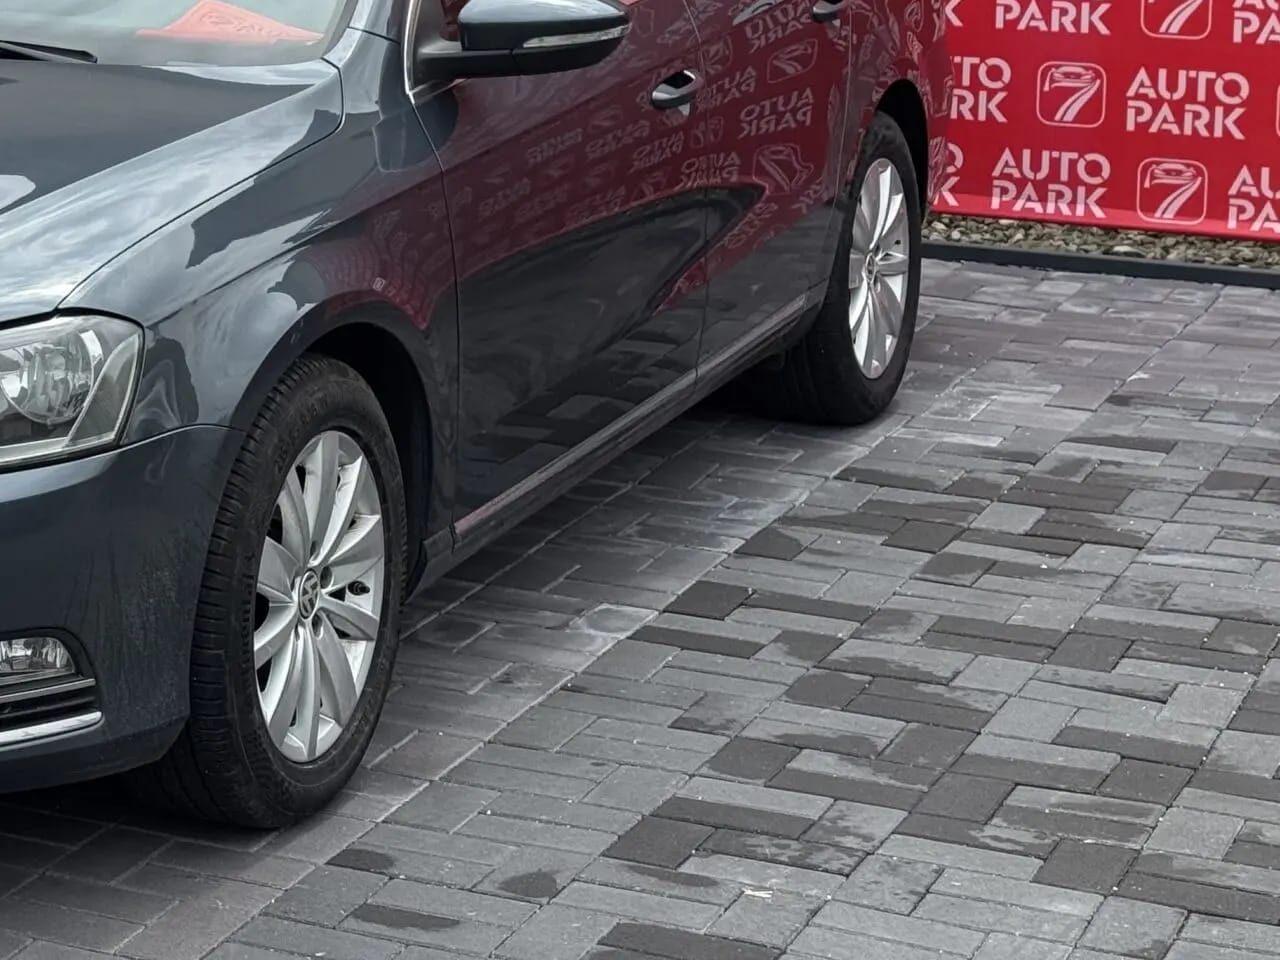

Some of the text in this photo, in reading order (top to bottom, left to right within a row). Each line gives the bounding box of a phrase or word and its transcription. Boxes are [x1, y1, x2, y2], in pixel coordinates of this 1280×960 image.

[1126, 67, 1249, 104] AUTO
[1126, 100, 1245, 139] PARK
[992, 148, 1110, 184] AUTO
[991, 180, 1107, 218] PARK
